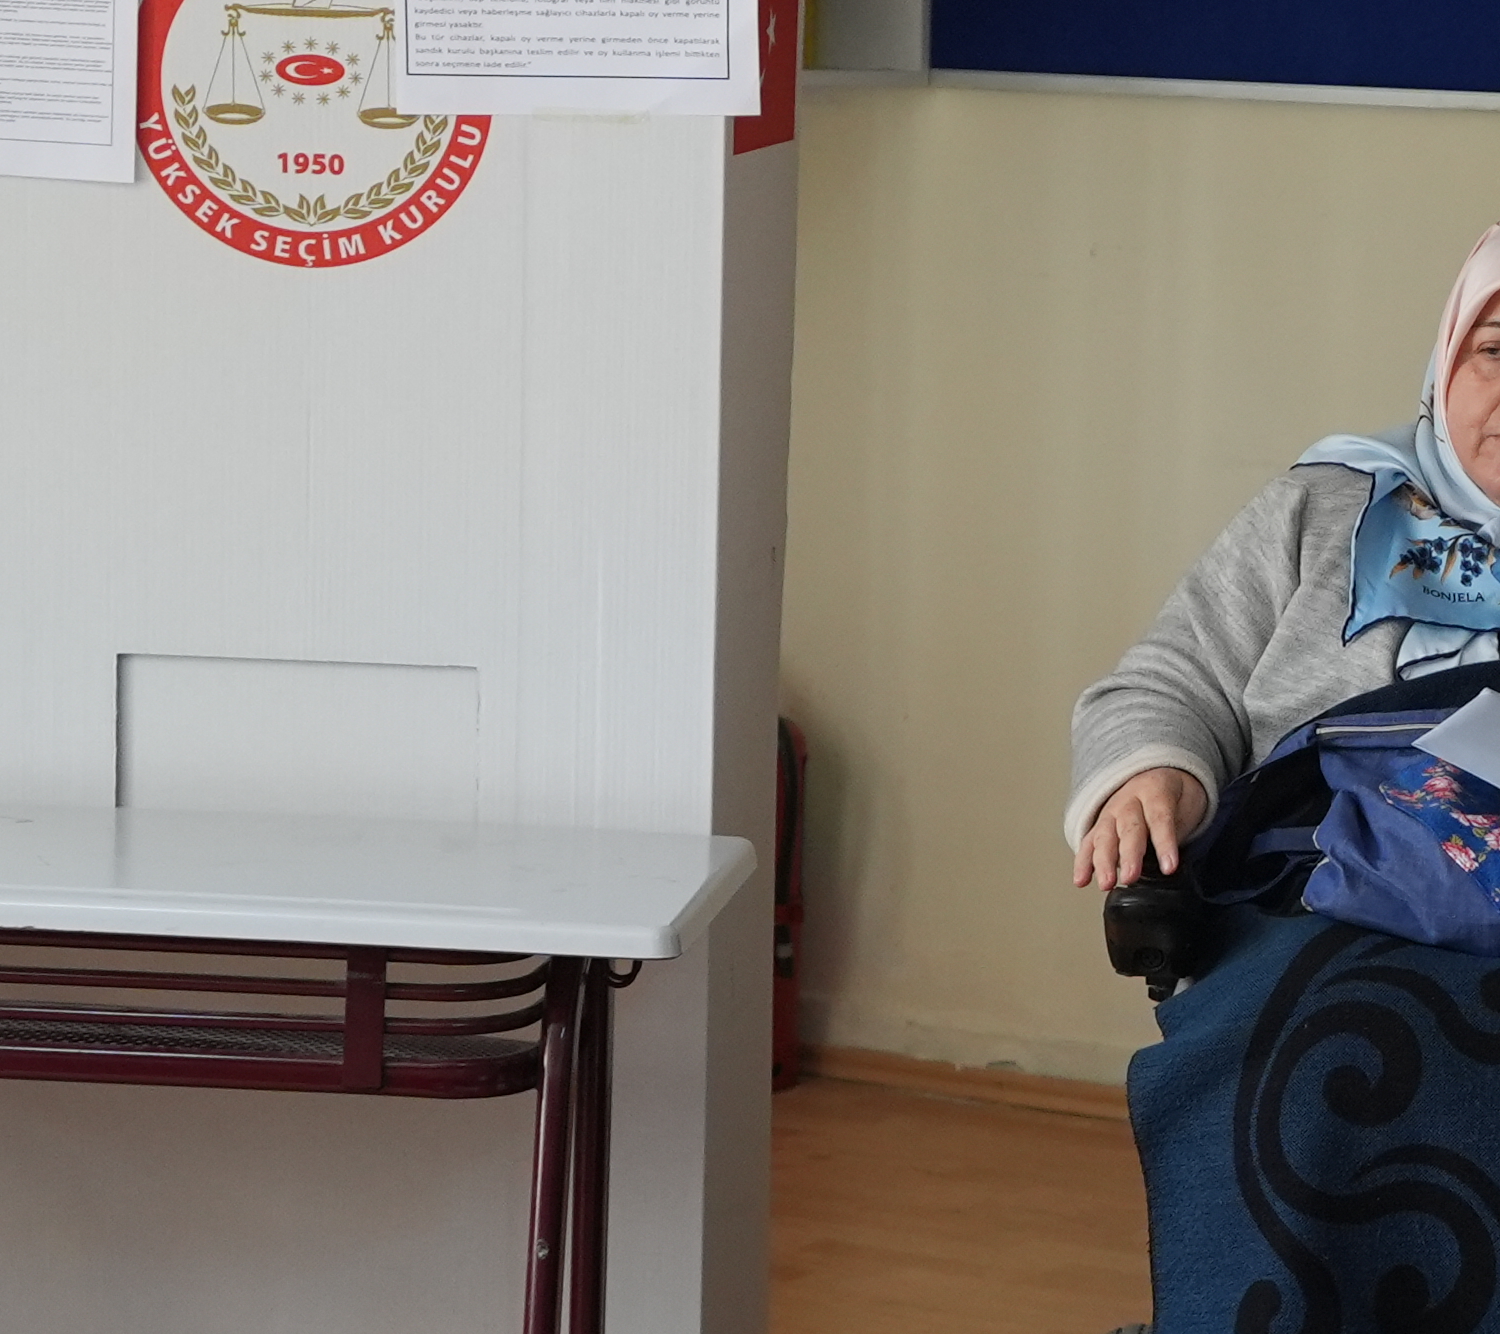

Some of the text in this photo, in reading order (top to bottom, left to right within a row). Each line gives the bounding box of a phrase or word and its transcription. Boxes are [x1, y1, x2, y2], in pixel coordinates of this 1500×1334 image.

[139, 111, 482, 267] YÜKSEK SEÇİM KURULU
[276, 152, 345, 175] 1950
